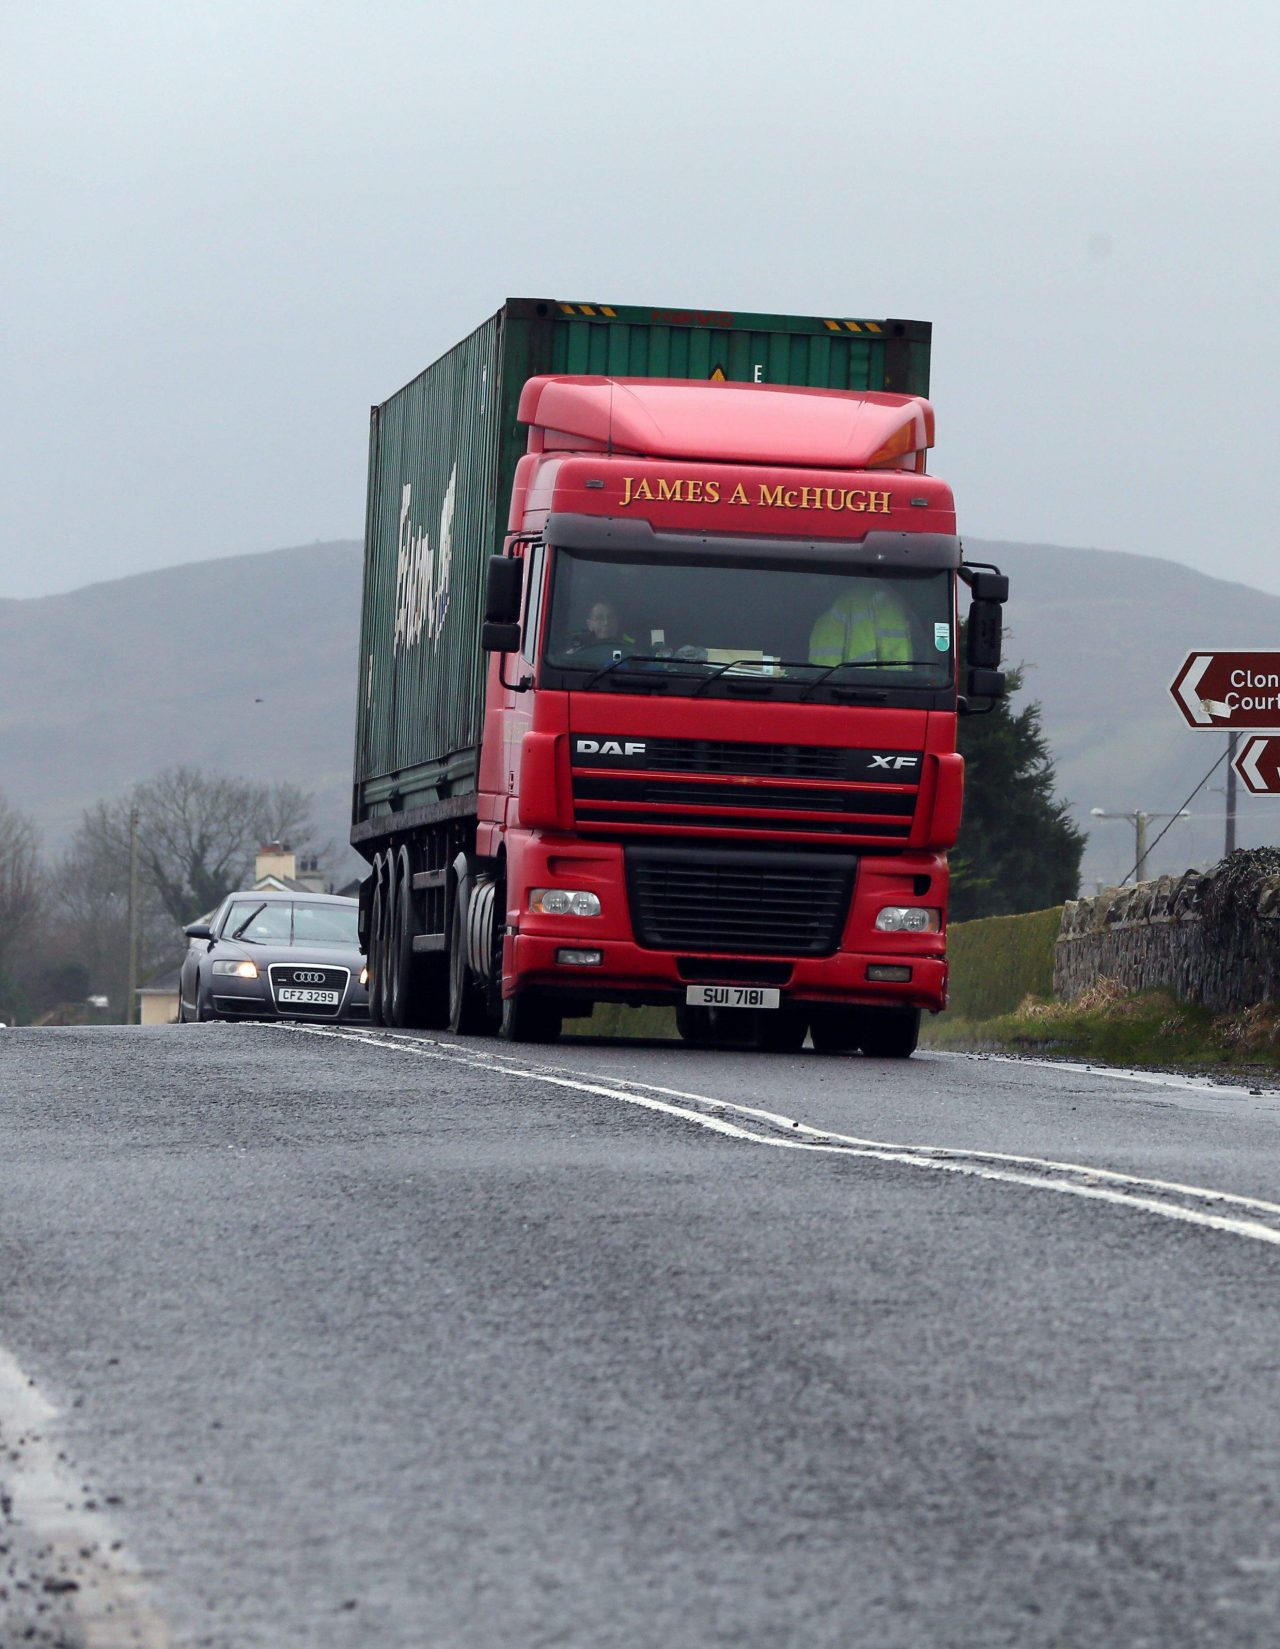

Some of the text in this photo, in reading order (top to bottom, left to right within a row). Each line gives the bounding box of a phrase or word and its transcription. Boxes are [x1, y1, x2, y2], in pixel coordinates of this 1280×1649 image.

[619, 477, 892, 514] JAMES A McHUGH
[577, 740, 646, 756] DAF
[866, 755, 918, 770] XF
[283, 990, 334, 1003] CFZ 3299
[703, 988, 764, 1005] SUI 7181
